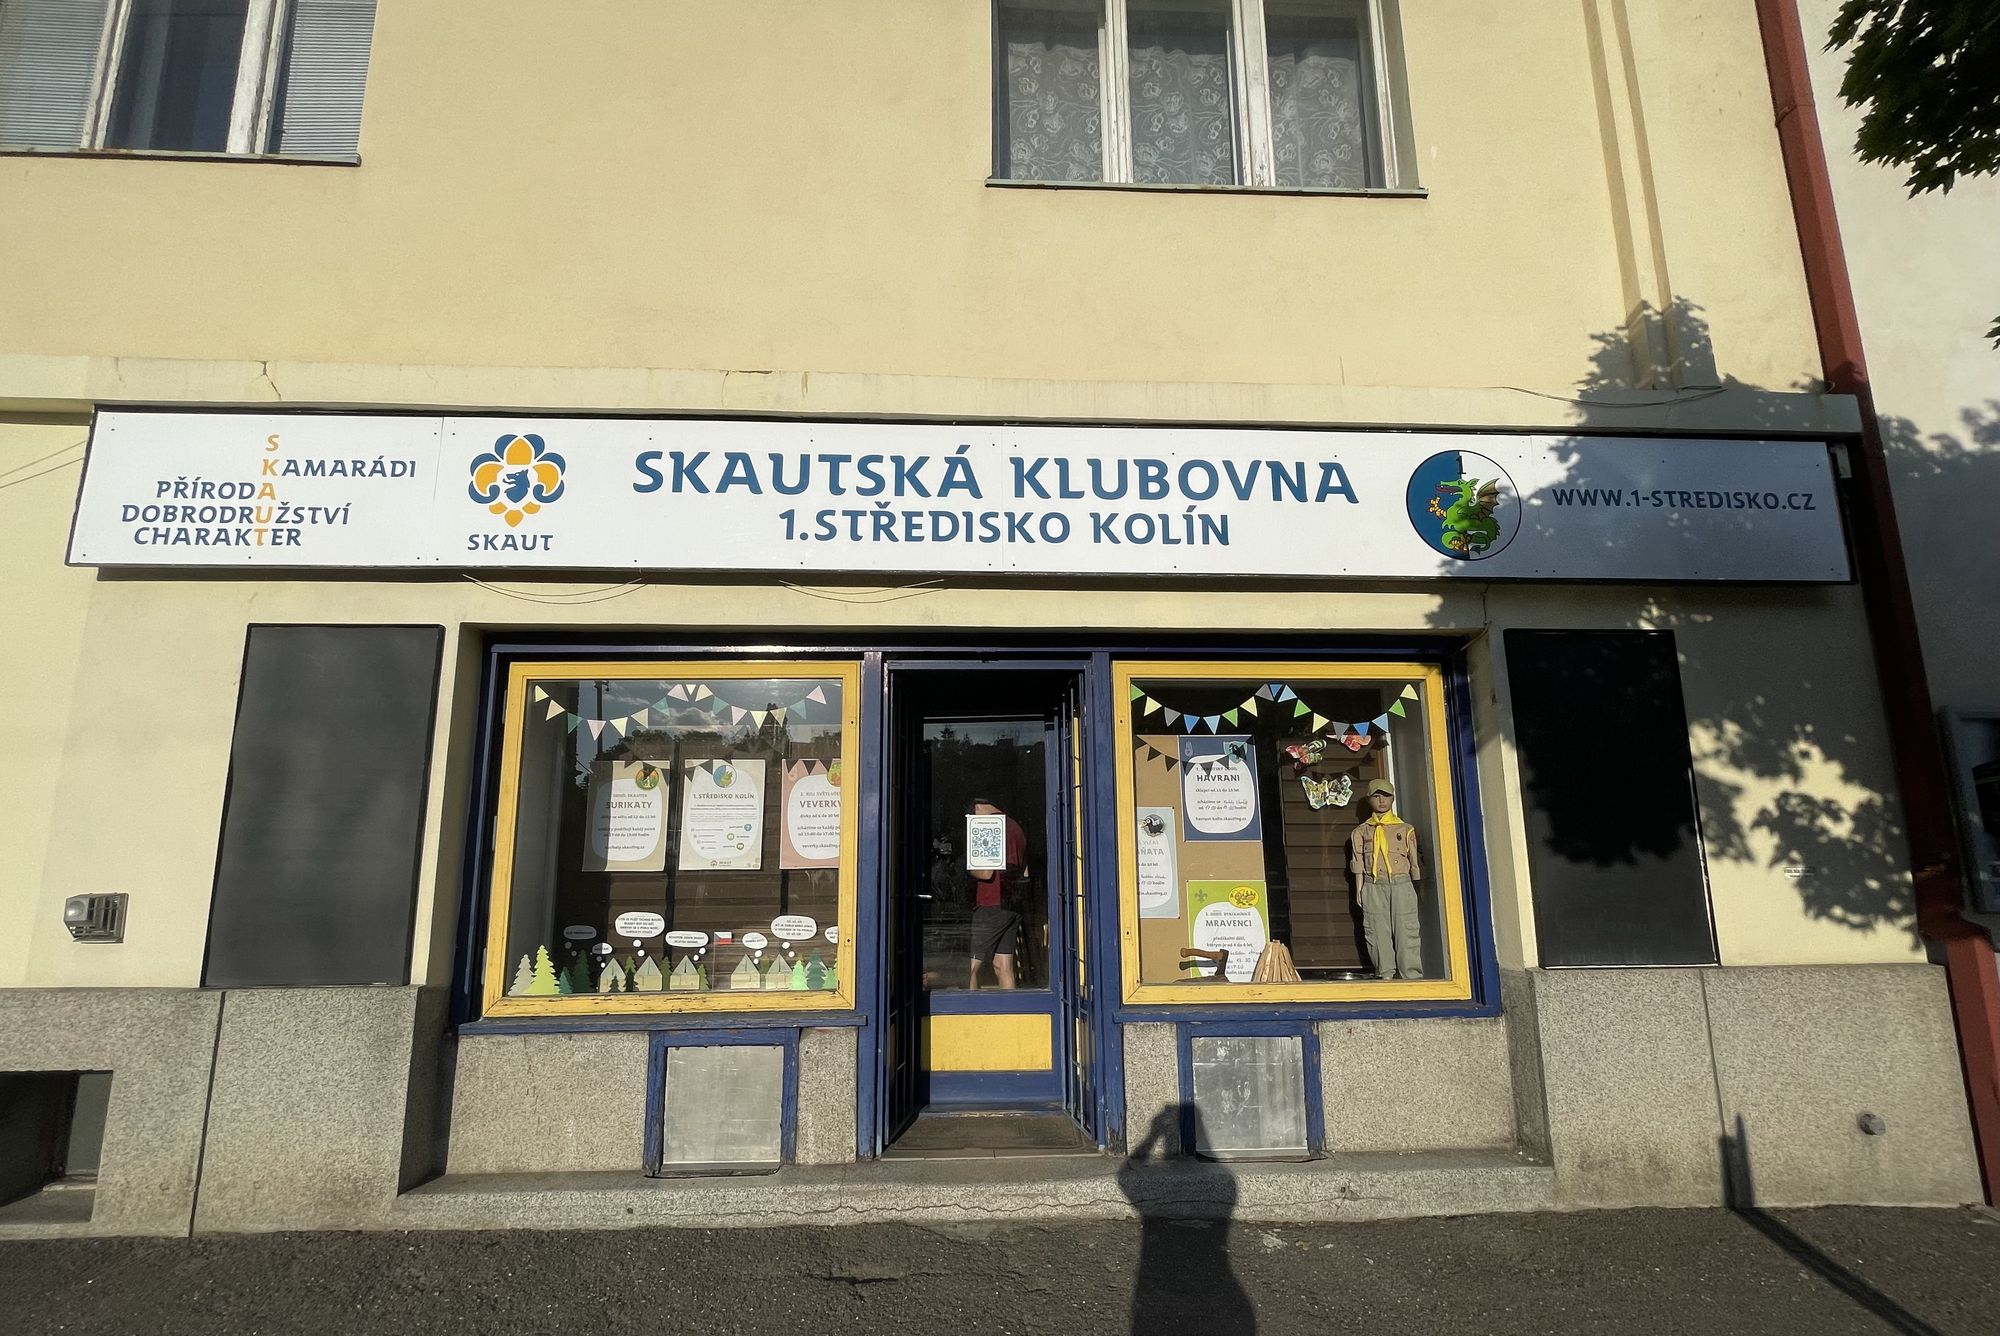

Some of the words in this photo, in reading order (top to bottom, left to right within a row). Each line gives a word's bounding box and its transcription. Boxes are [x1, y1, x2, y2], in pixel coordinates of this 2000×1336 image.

[263, 455, 416, 478] KAMARÁDI
[633, 445, 983, 499] SKAUTSKÁ
[1009, 457, 1359, 504] KLUBOVNA
[157, 476, 275, 500] PŘÍRODA
[1552, 486, 1816, 510] WWW.1-STREDISKO.CZ
[122, 502, 352, 525] DOBRODRUŽSTVÍ
[779, 501, 1070, 544] 1.STŘEDISKO
[1089, 505, 1229, 546] KOLÍN
[134, 527, 301, 547] CHARAKTER
[468, 534, 553, 551] SKAUT
[1196, 774, 1240, 782] HAVRANI
[605, 801, 653, 809] SURIKATY
[1205, 919, 1252, 927] MRAVENCI
